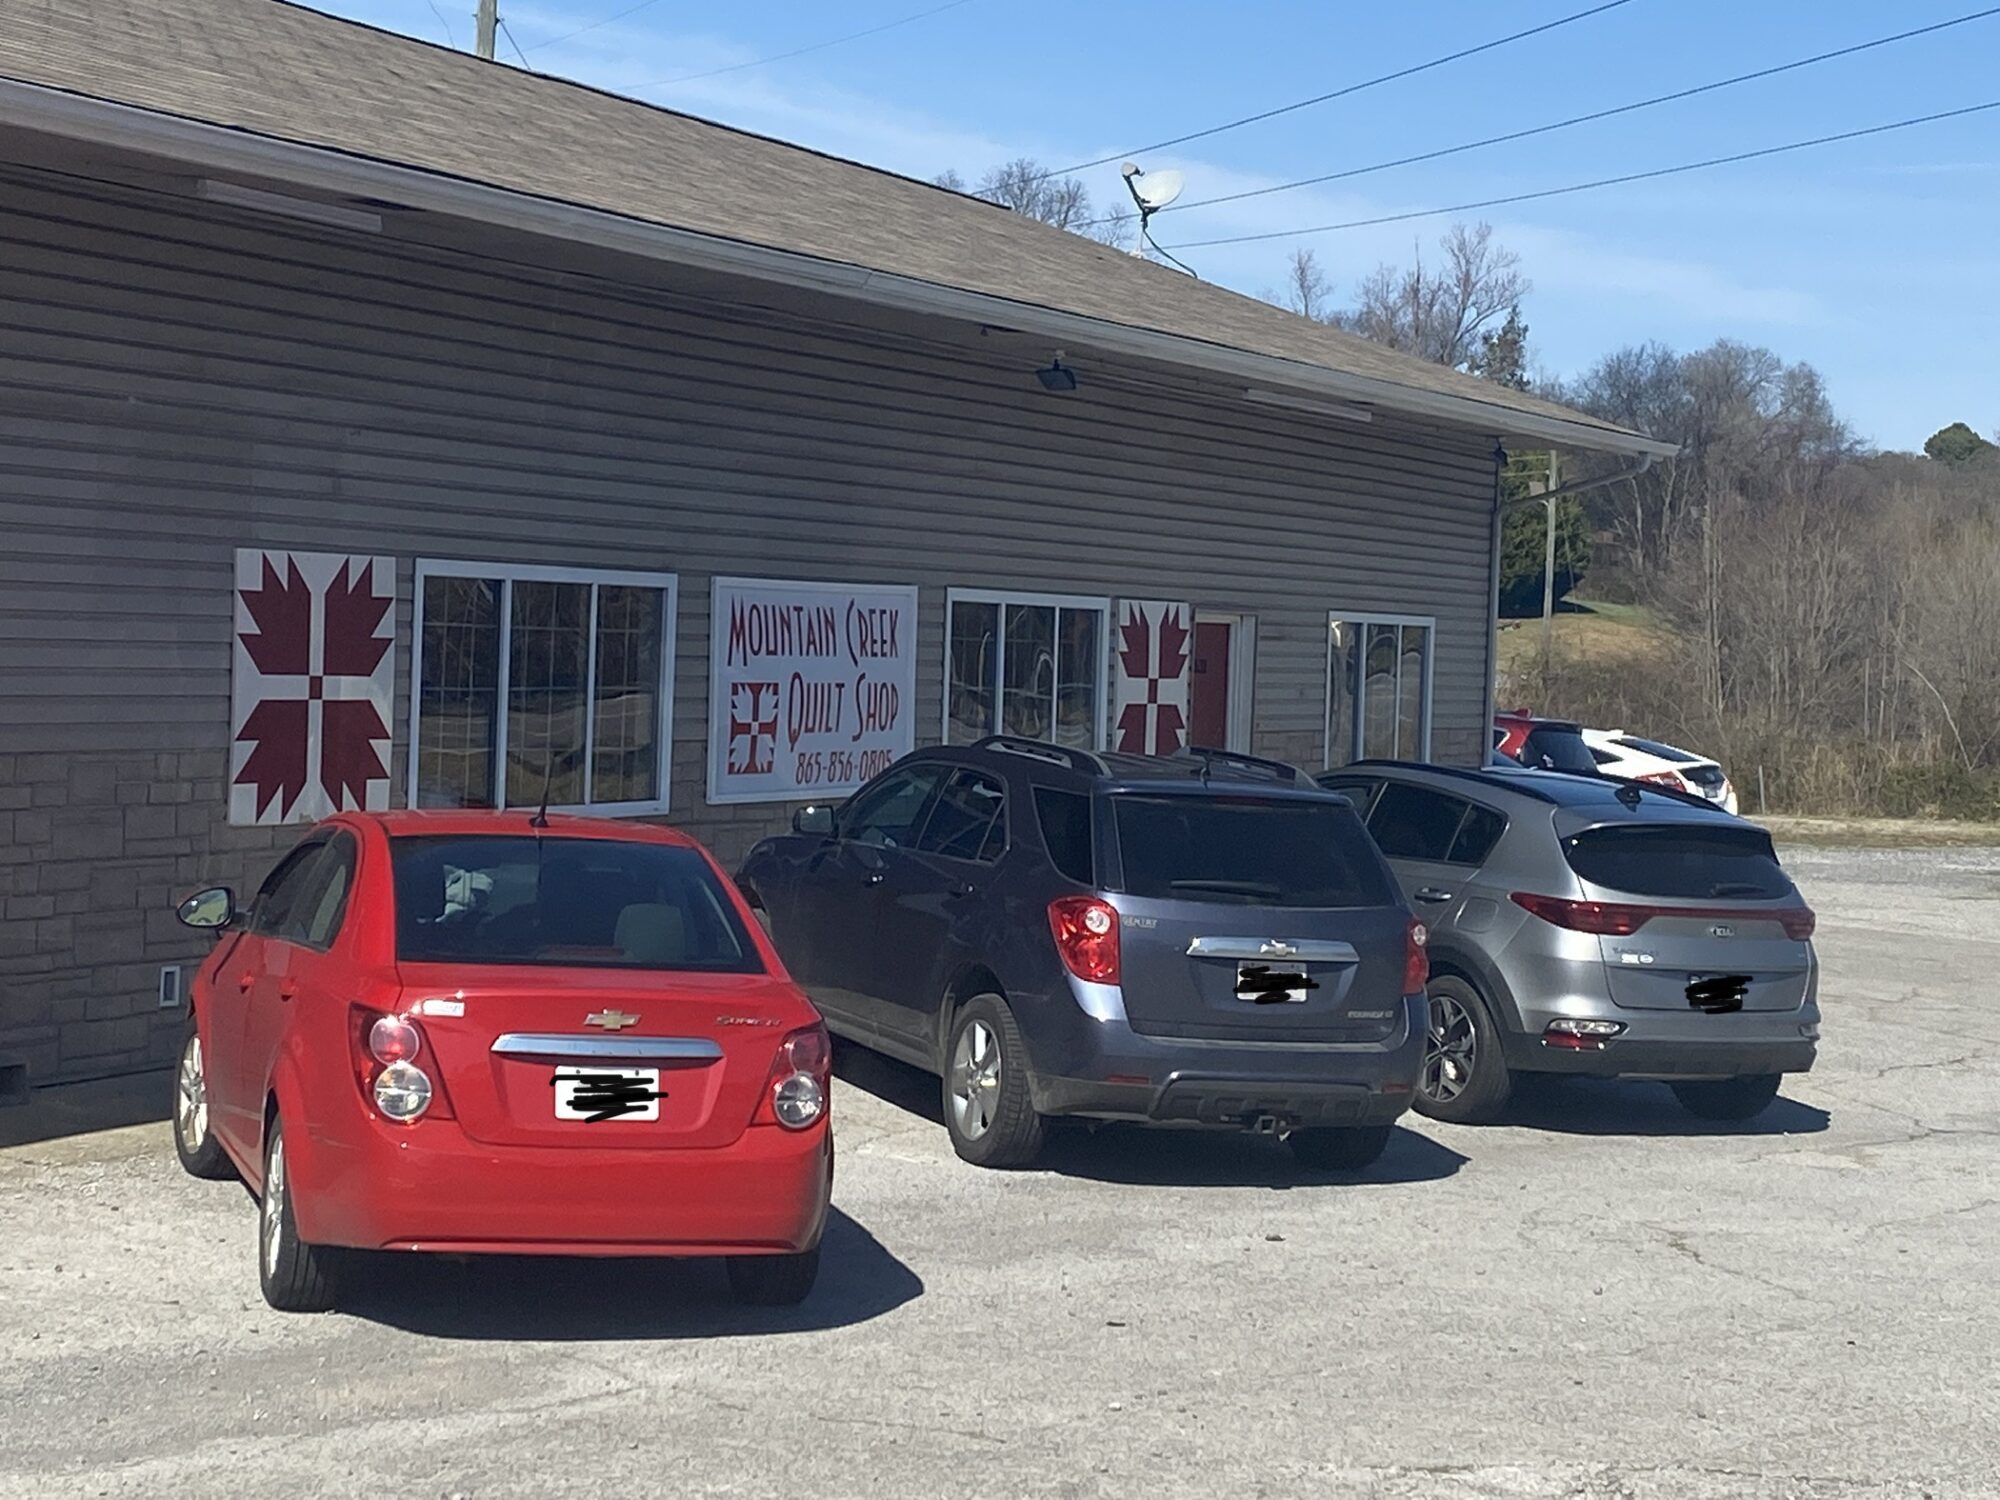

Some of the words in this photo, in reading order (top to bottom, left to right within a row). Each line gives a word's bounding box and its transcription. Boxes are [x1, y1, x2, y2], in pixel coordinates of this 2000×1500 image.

[727, 594, 837, 667] MOUNTAIN
[845, 598, 899, 668] CREEK
[787, 671, 845, 753] QUILT
[851, 672, 899, 742] SHOP
